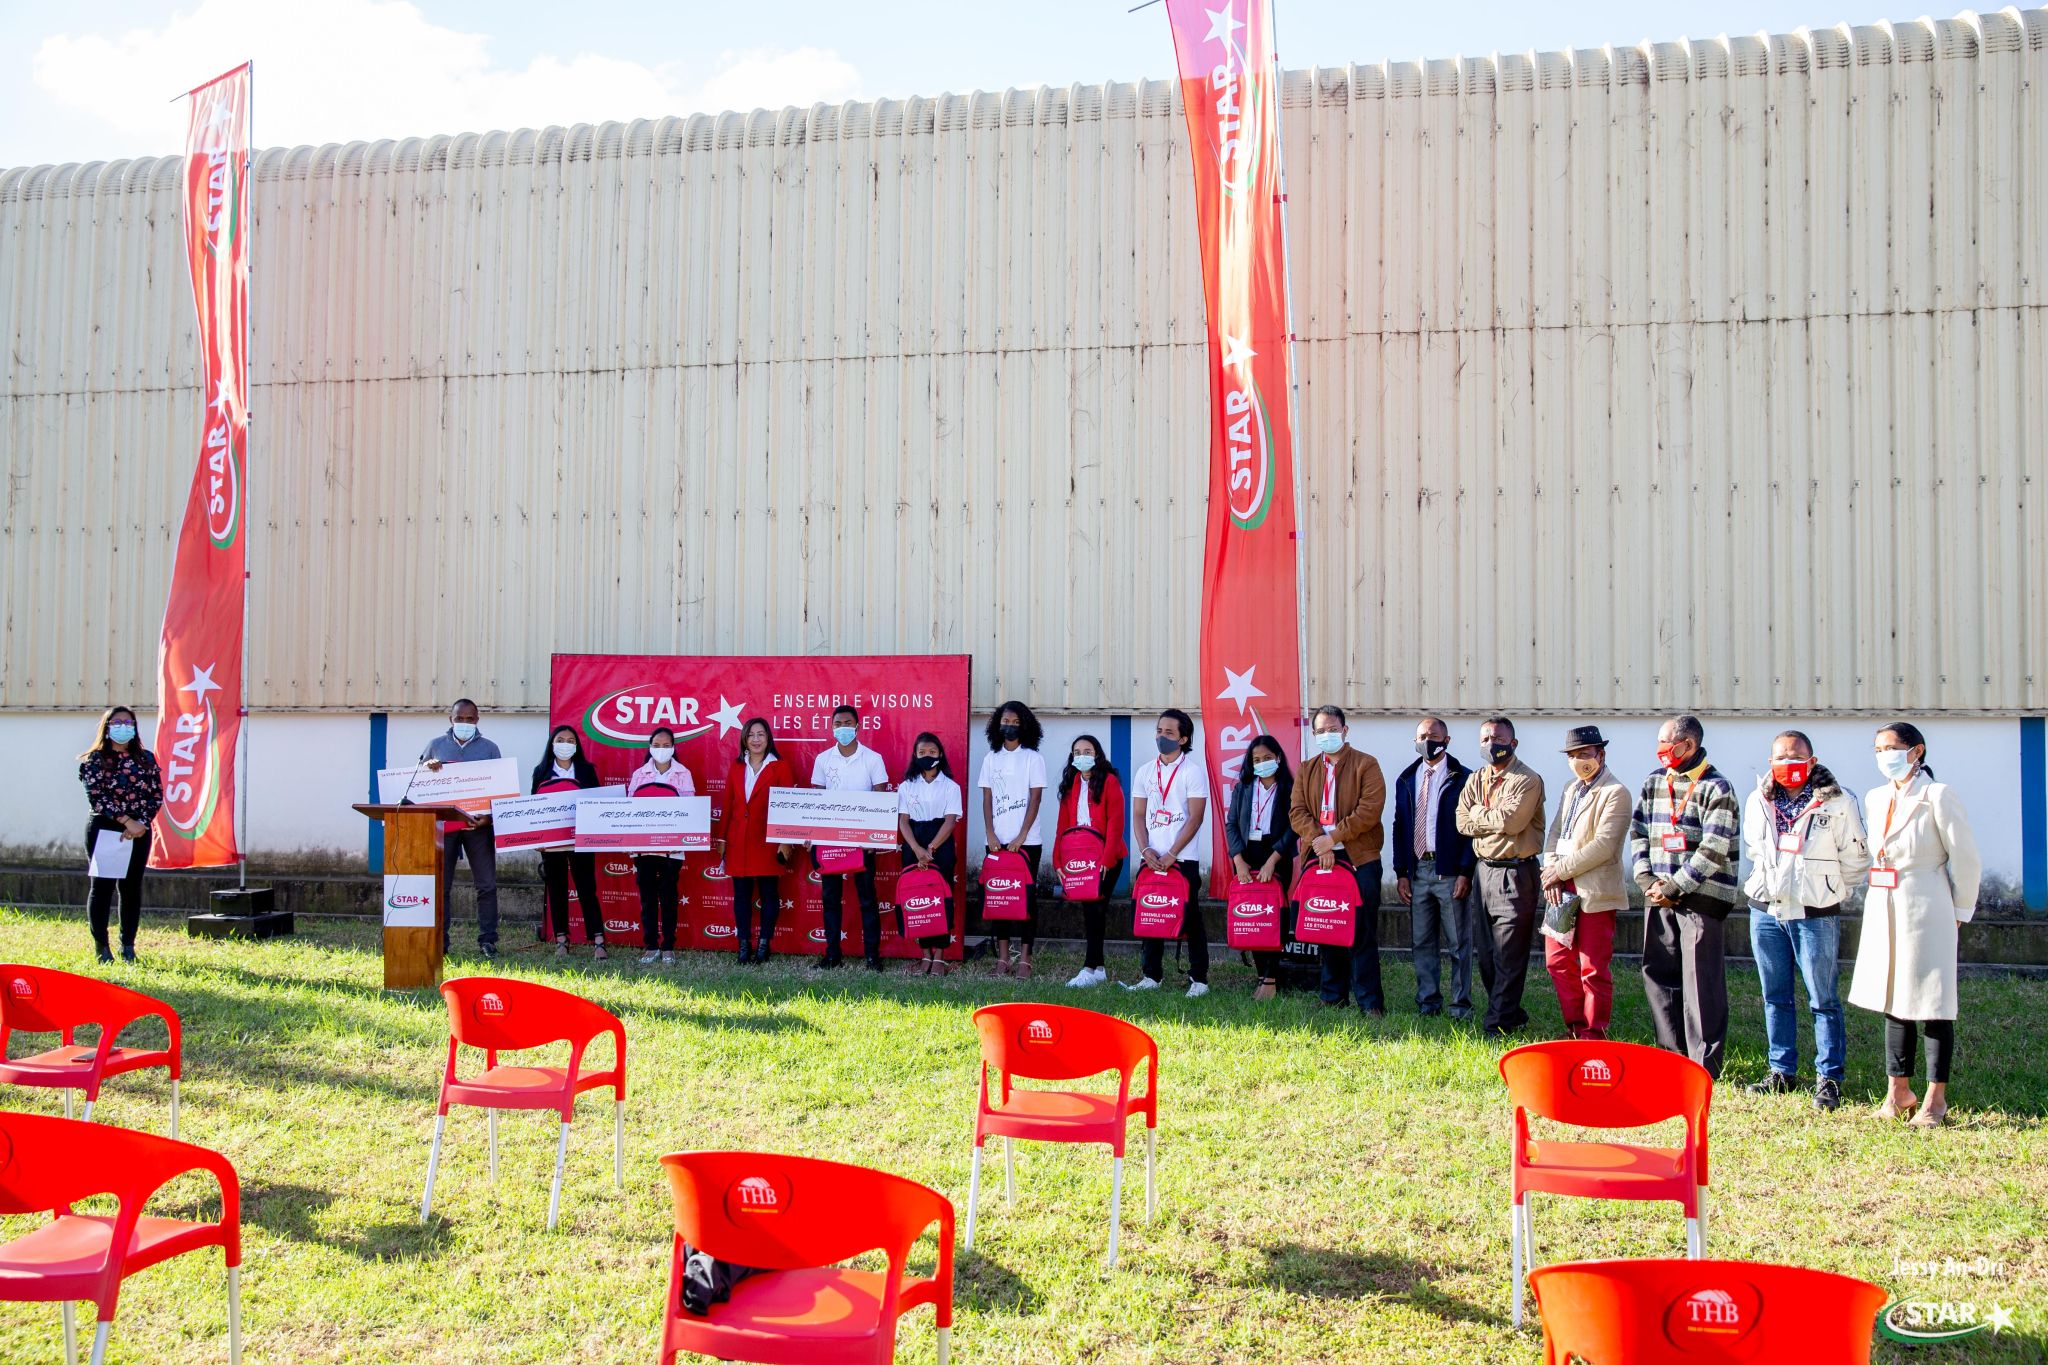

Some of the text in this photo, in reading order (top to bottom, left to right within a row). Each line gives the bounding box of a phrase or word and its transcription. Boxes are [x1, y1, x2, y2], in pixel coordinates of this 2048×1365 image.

[1212, 56, 1241, 164] STAR
[208, 146, 227, 233] STAR
[1226, 383, 1252, 490] STAR
[207, 423, 227, 515] STAR
[615, 695, 700, 725] STAR
[871, 694, 933, 708] VISONS
[773, 713, 881, 730] LES ÉTES
[165, 712, 205, 803] STAR
[1221, 723, 1252, 824] TAR
[609, 863, 628, 871] STAR
[1069, 860, 1086, 868] STAR
[991, 879, 1010, 887] STAR
[396, 895, 418, 903] STAR
[910, 897, 930, 906] STAR
[1147, 895, 1168, 904] STAR
[1312, 898, 1337, 908] STAR
[1240, 903, 1263, 912] STAR
[609, 920, 629, 928] STAR
[710, 925, 730, 933] STAR
[815, 929, 826, 937] ST
[13, 983, 32, 994] THB
[481, 999, 504, 1010] THB
[1027, 1026, 1053, 1038] THB
[1580, 1066, 1611, 1080] THB
[738, 1186, 777, 1205] THB
[1686, 1300, 1740, 1323] THB
